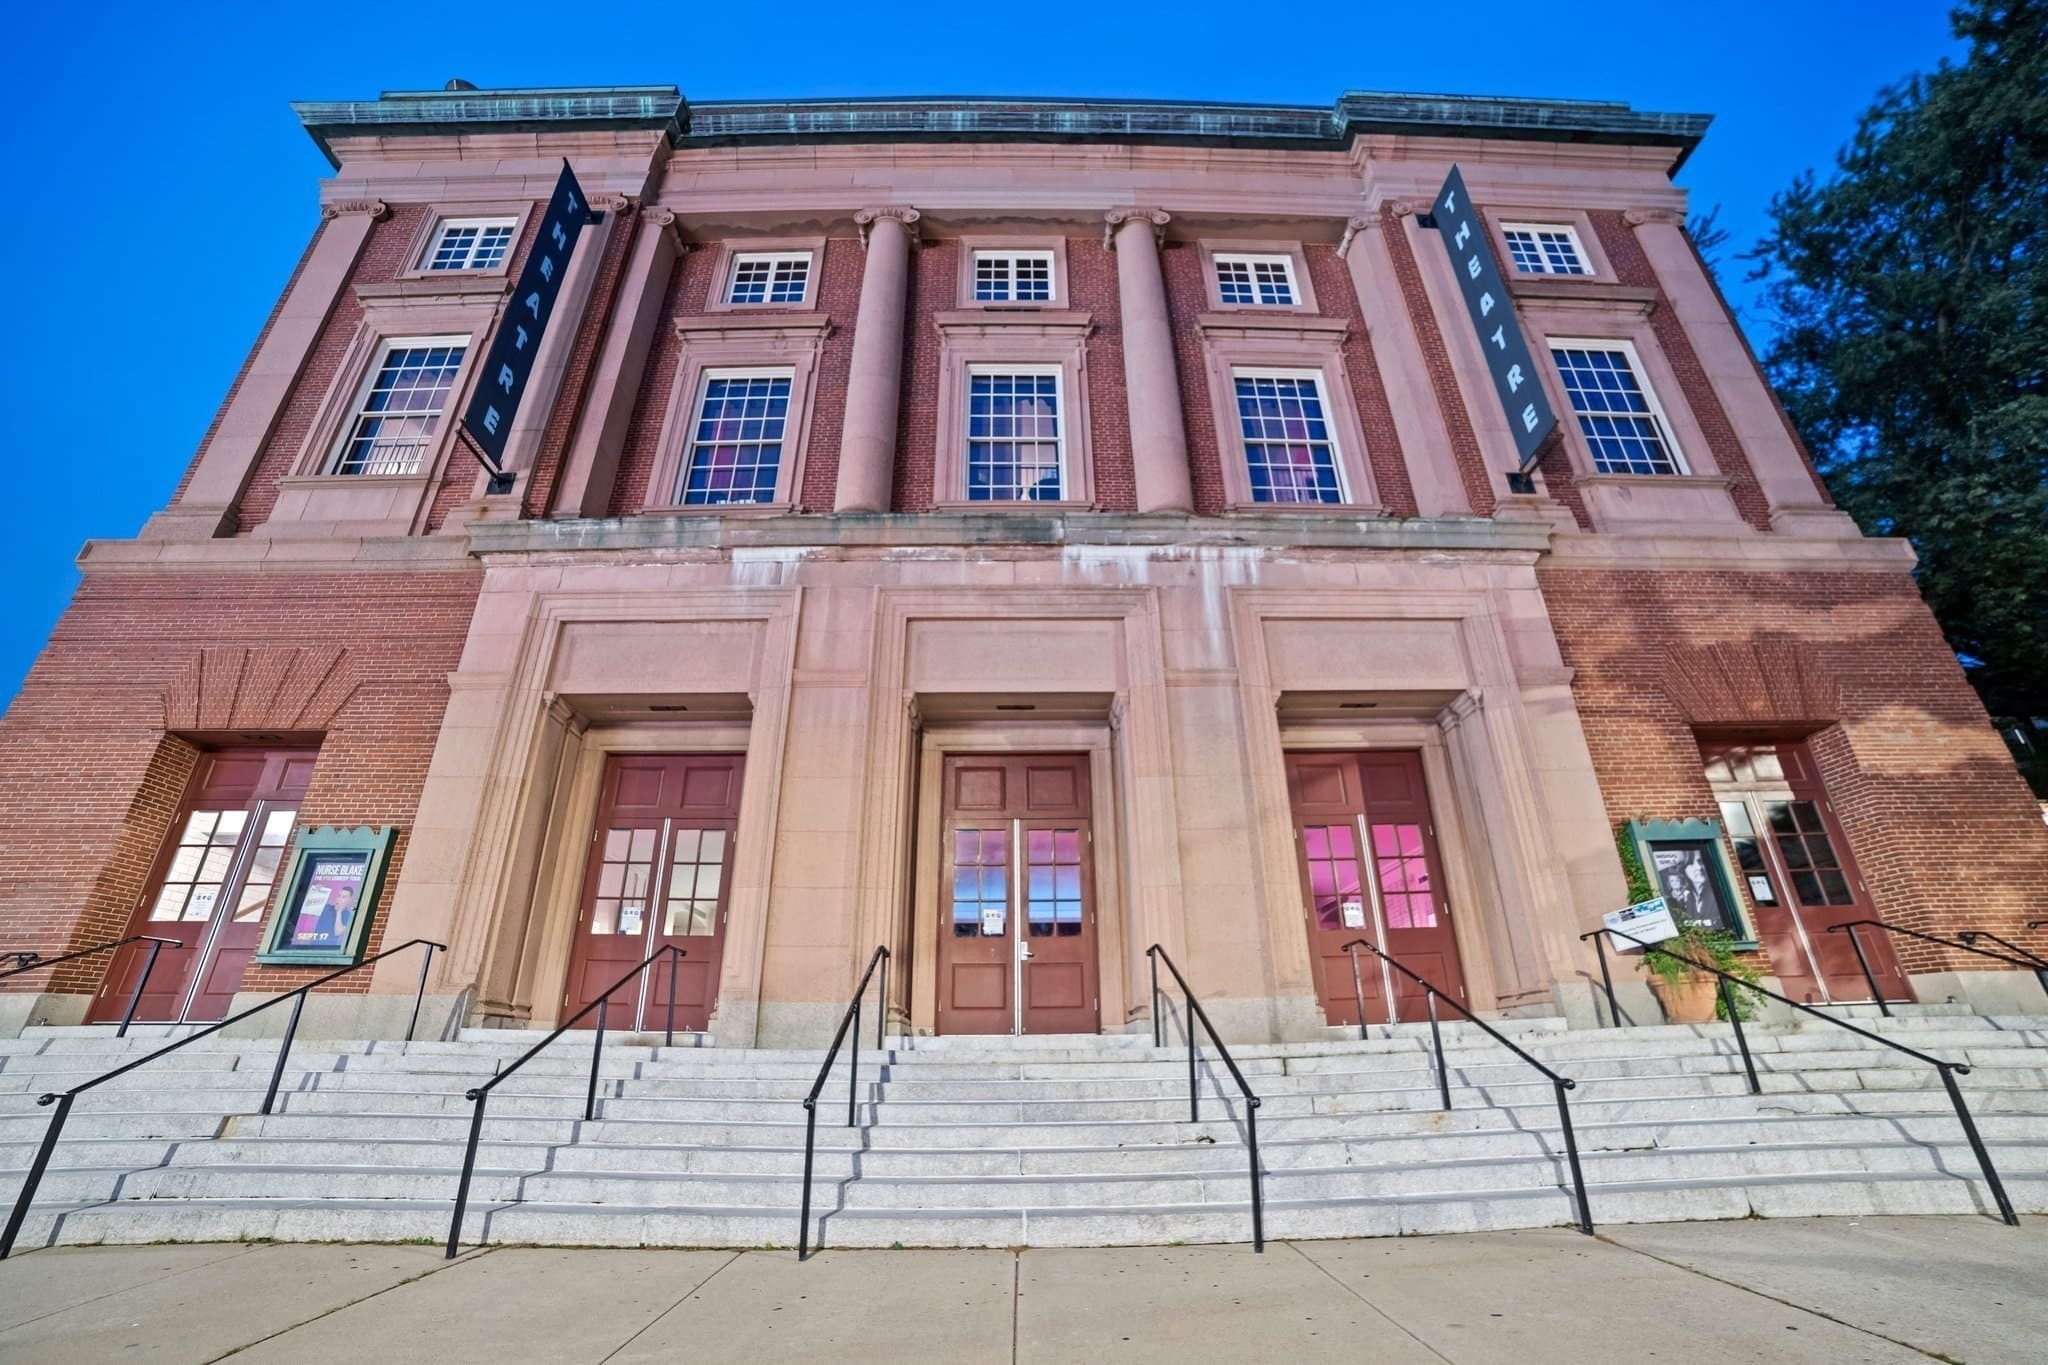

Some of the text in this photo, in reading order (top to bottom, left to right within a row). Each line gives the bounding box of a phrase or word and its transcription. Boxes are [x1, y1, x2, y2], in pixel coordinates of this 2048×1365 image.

[484, 191, 578, 435] THEATRE
[1444, 191, 1538, 433] THEATRE
[315, 864, 365, 876] NURSE BLAKE
[297, 932, 329, 941] SEPT 17
